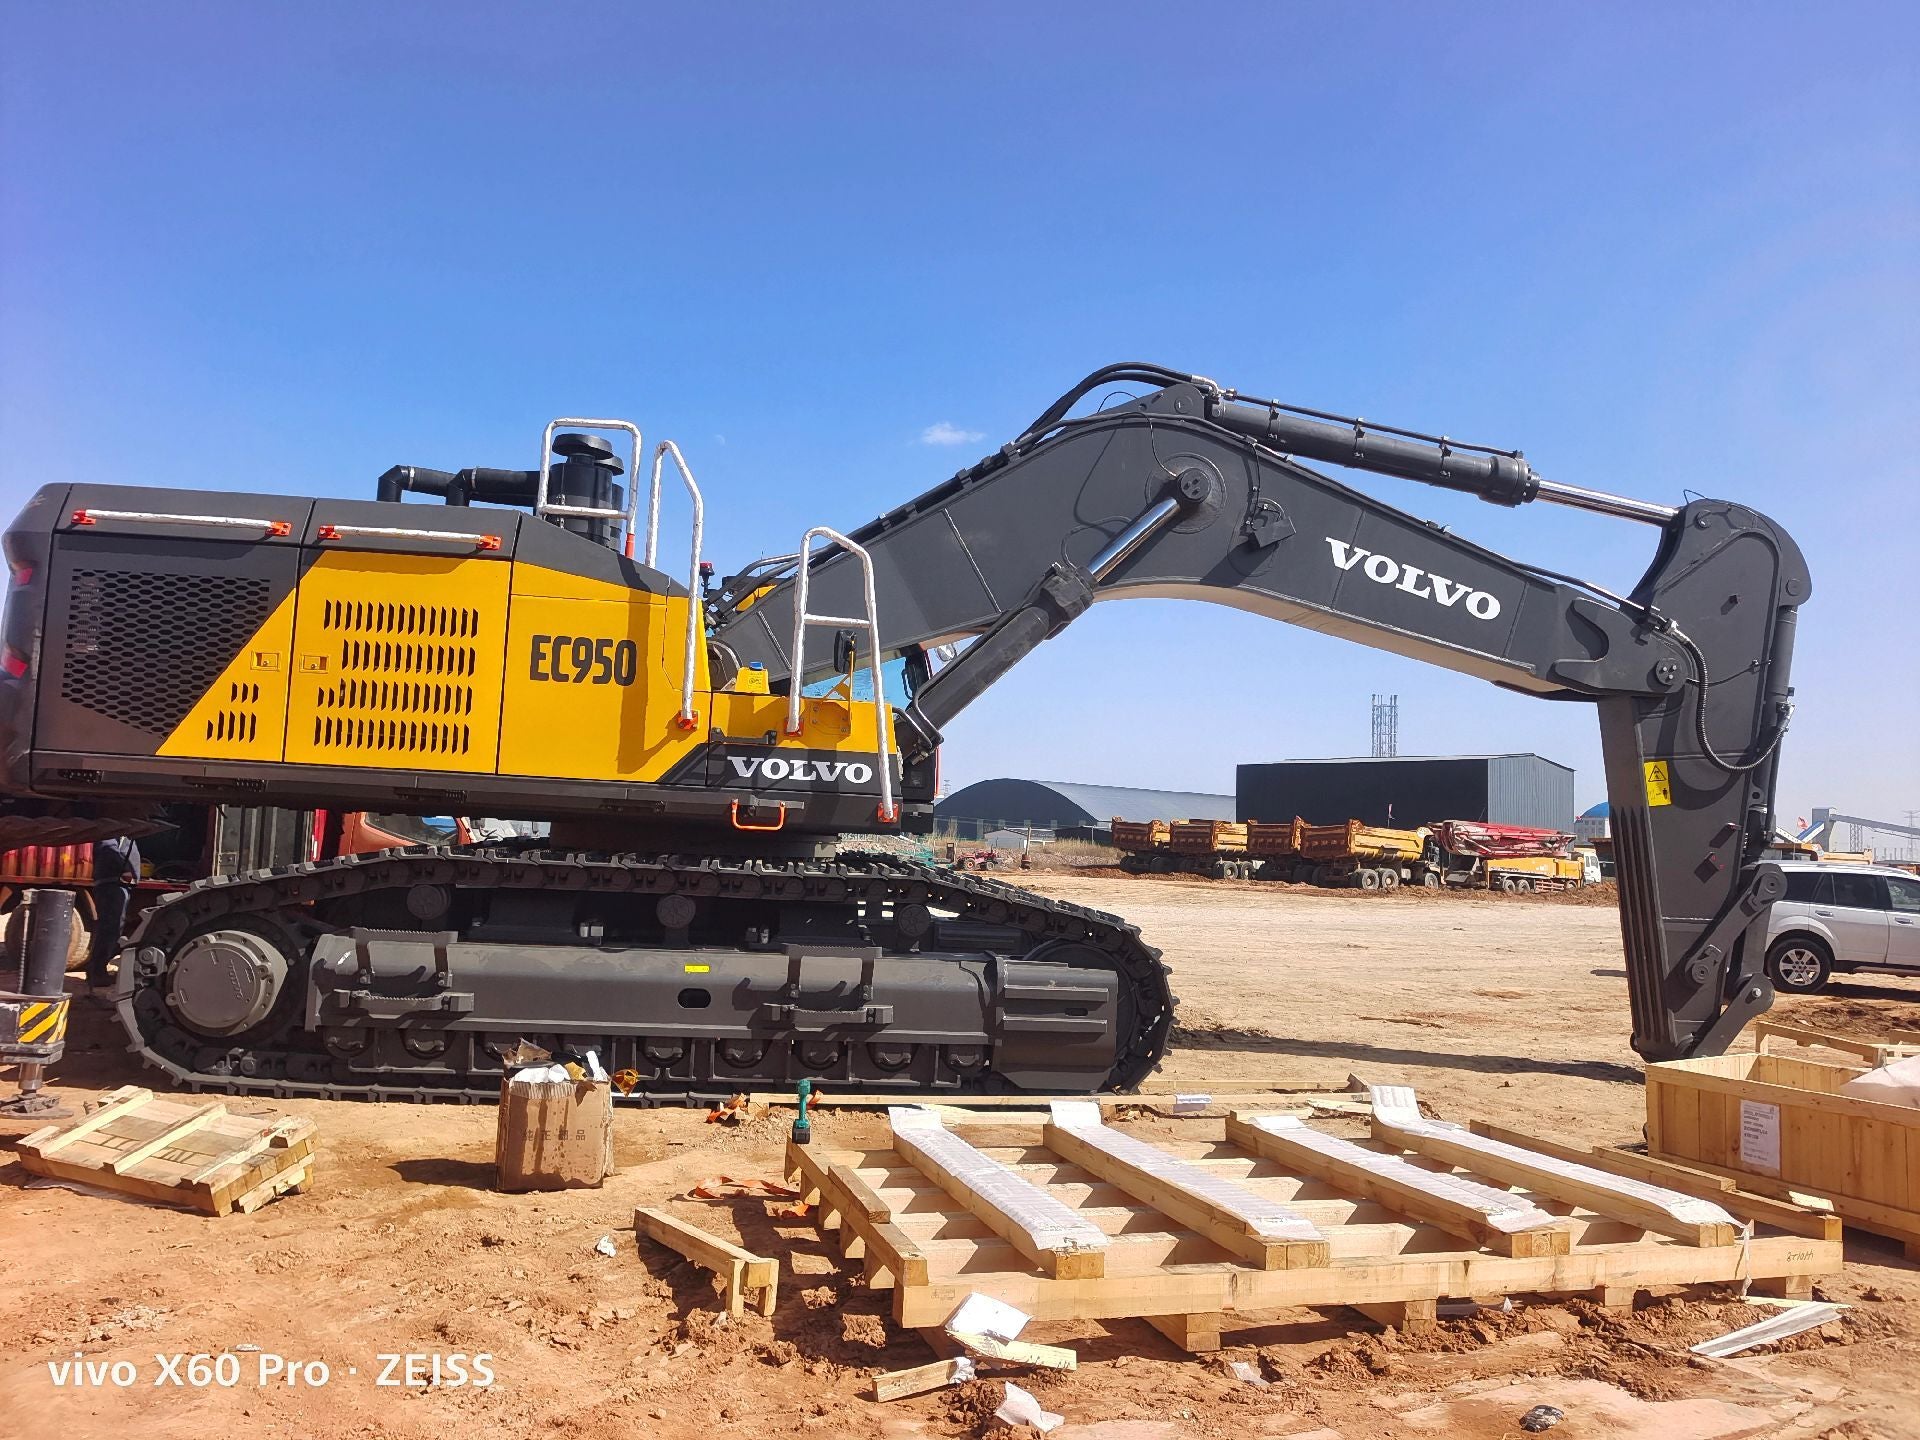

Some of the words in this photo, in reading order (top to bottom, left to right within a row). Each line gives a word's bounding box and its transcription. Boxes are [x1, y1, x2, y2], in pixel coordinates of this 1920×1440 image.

[1325, 537, 1501, 620] VOLVO
[530, 635, 637, 687] EC950
[727, 756, 873, 784] VOLVO
